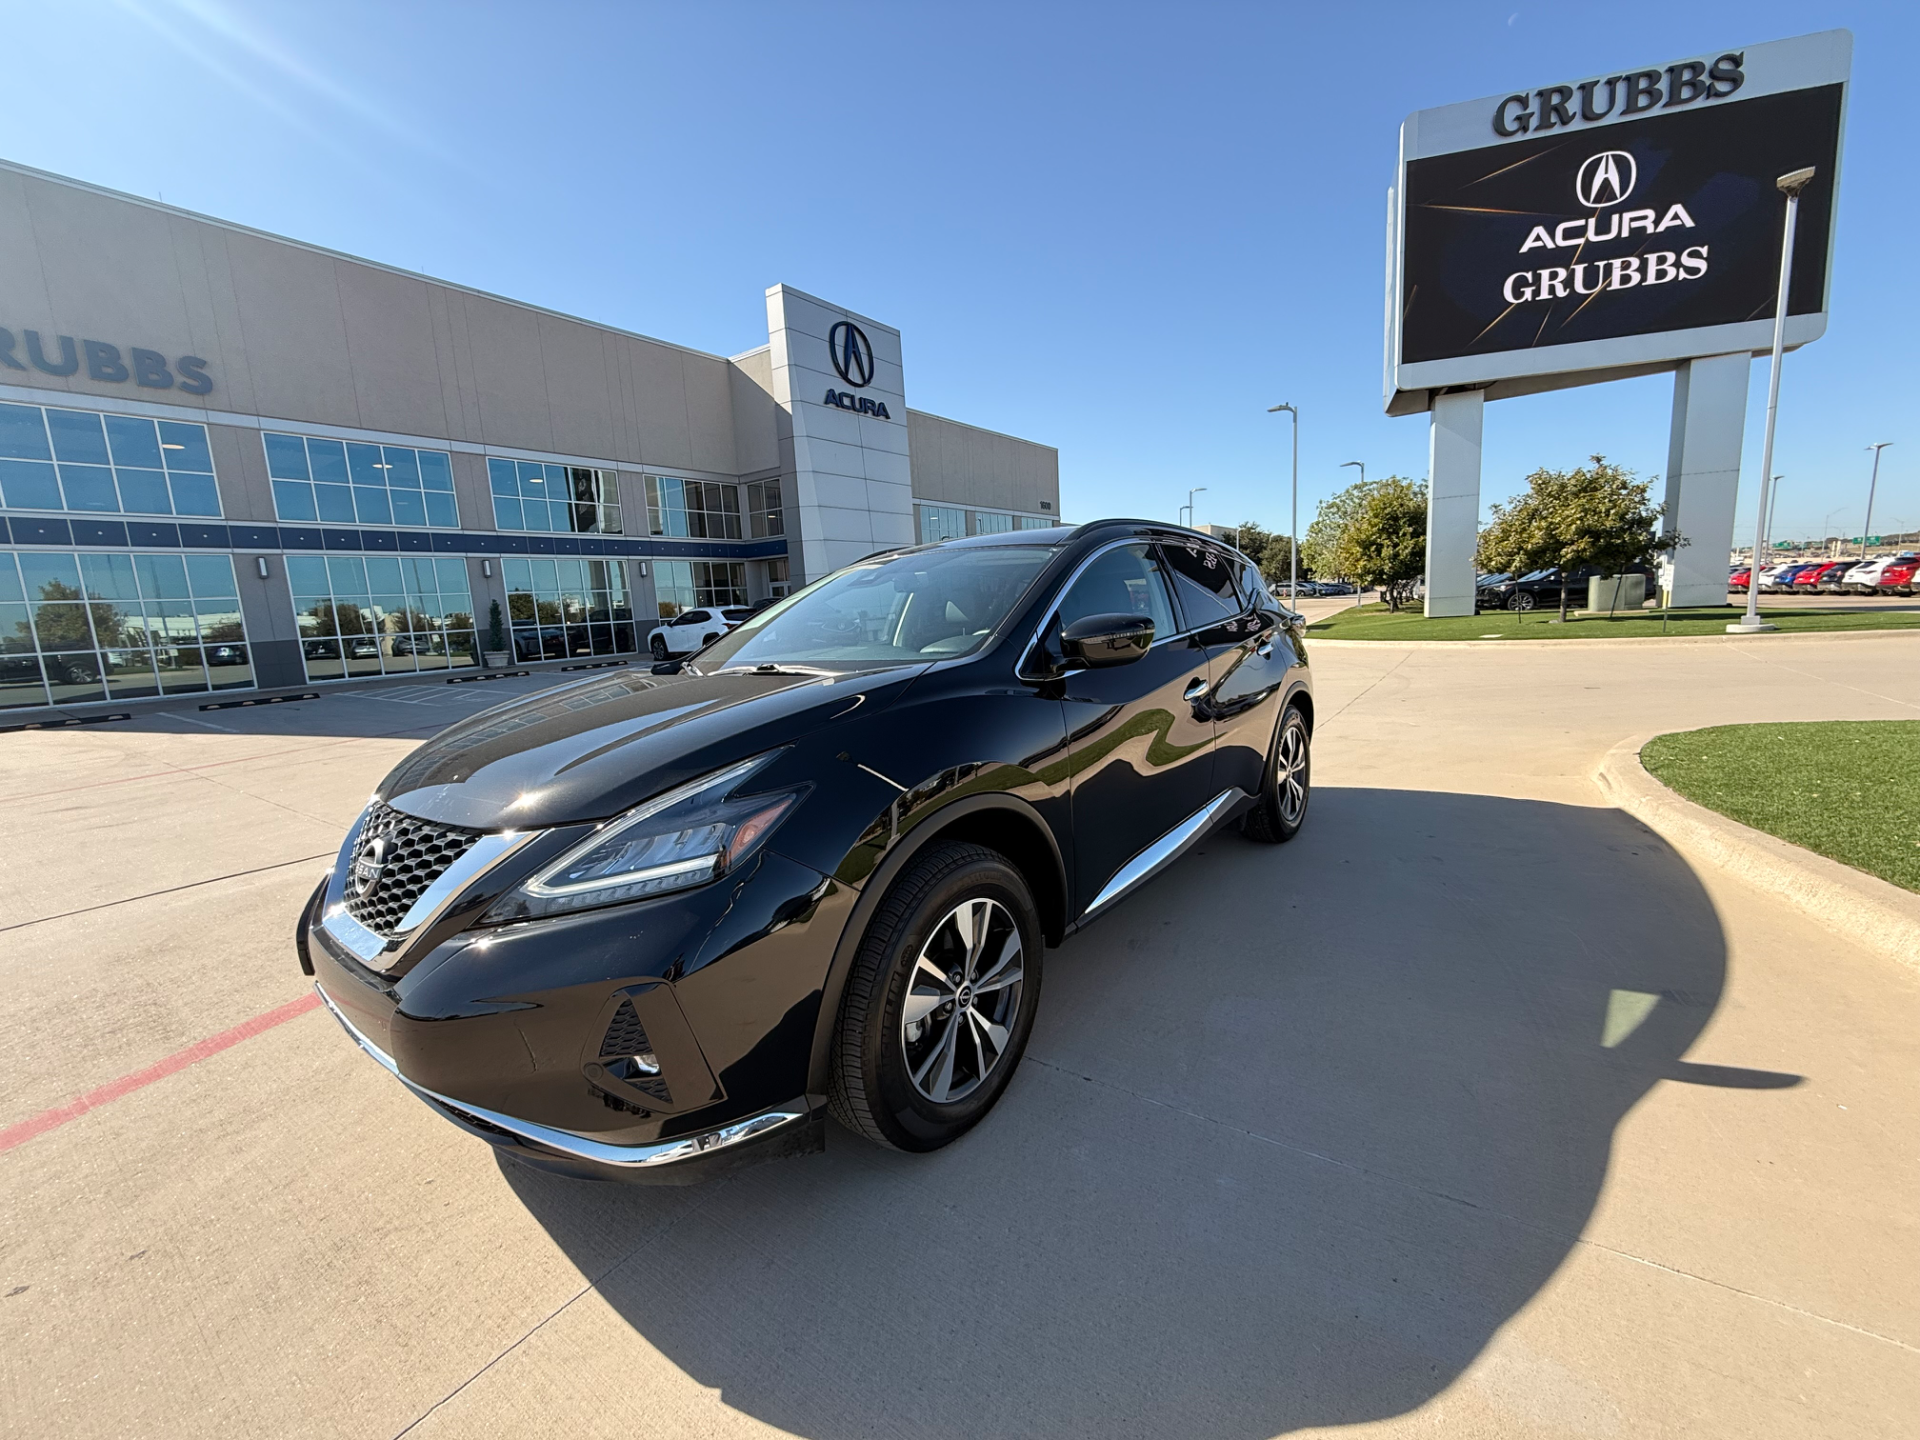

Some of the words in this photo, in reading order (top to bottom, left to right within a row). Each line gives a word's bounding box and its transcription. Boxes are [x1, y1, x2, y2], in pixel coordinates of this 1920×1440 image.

[1492, 51, 1745, 137] GRUBBS
[1518, 203, 1696, 253] ACURA
[1502, 245, 1709, 304] GRUBBS
[824, 388, 891, 420] ACURA
